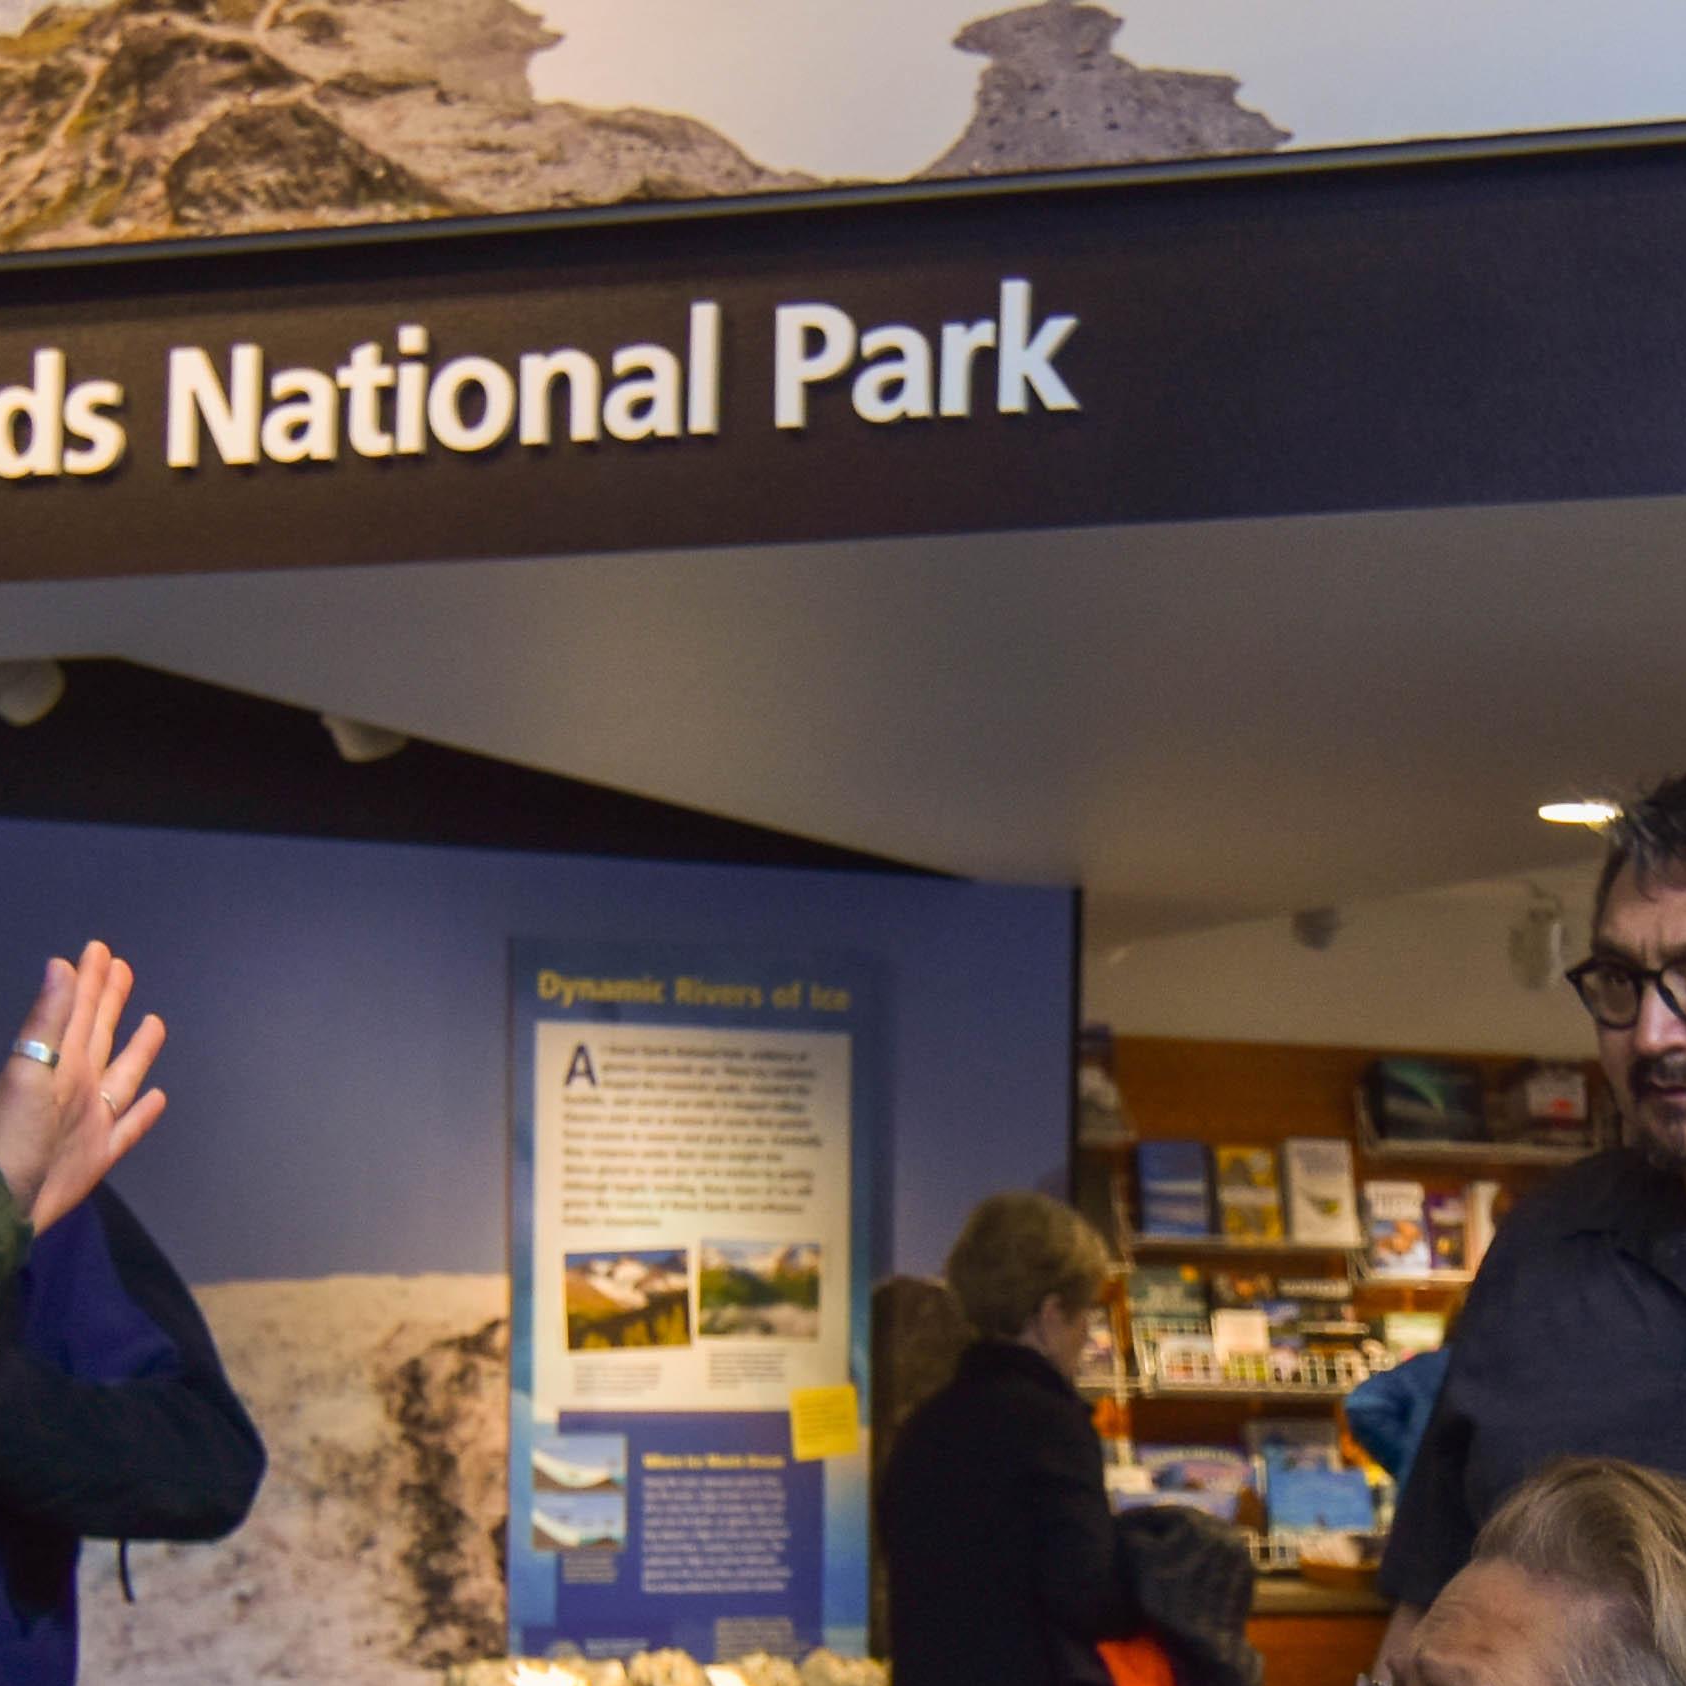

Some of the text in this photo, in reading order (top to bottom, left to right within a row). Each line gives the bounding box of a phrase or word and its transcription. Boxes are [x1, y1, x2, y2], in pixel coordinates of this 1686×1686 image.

[166, 301, 721, 470] National
[773, 278, 1081, 430] Park
[537, 969, 850, 1011] Dynamic Rivers of Ice
